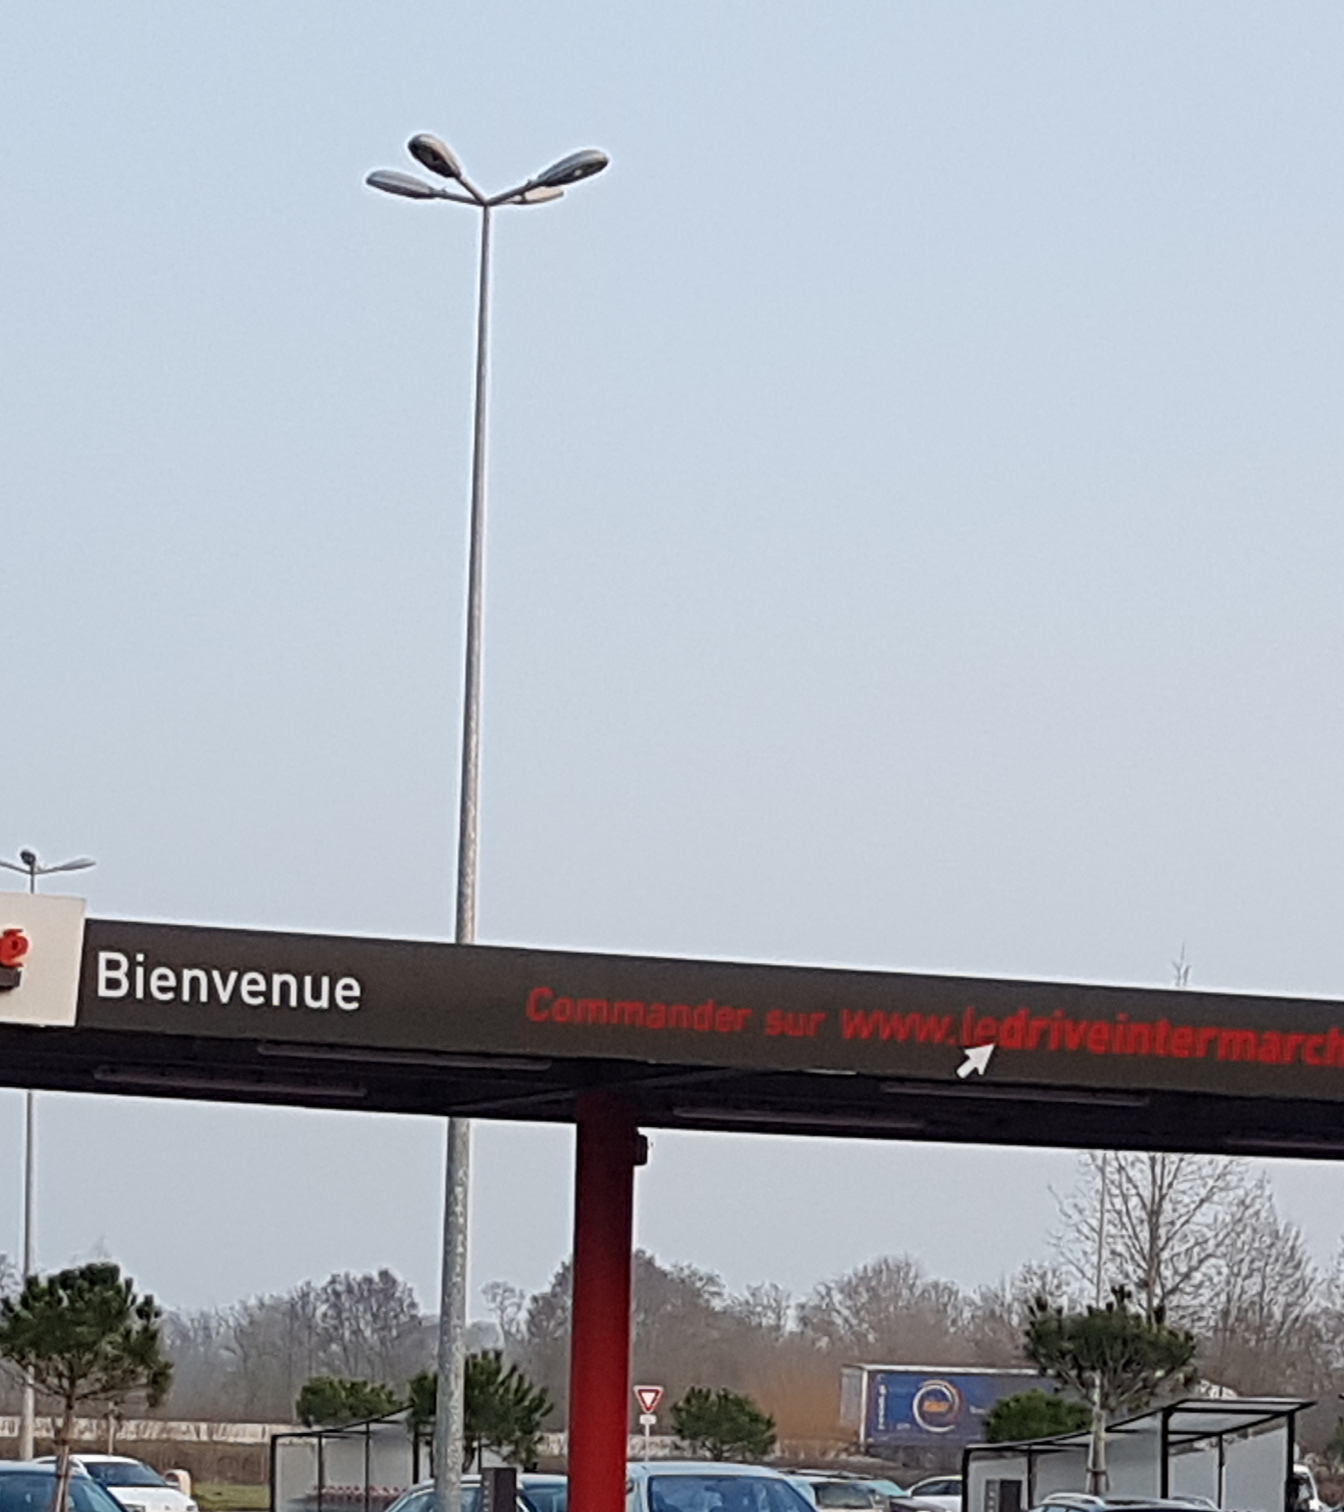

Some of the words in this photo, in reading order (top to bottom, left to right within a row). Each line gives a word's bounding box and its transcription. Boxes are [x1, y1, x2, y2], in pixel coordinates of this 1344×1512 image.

[96, 951, 362, 1011] Bienvenue
[526, 986, 751, 1032] Commander
[765, 1007, 824, 1036] sur
